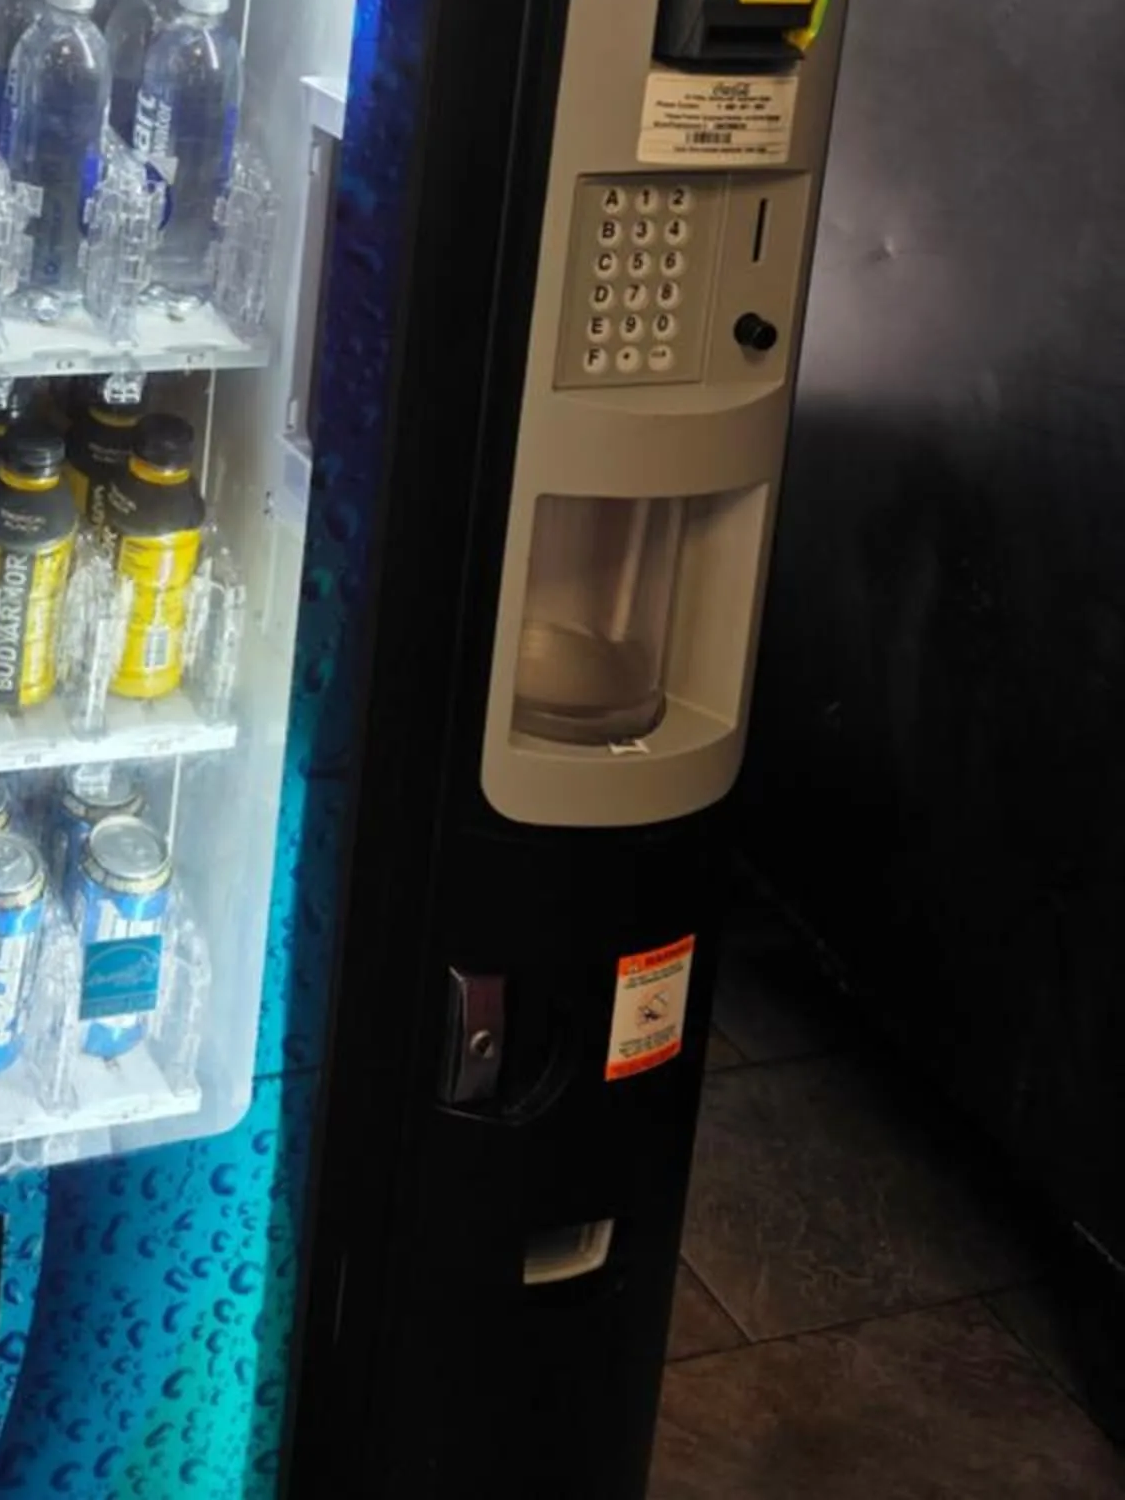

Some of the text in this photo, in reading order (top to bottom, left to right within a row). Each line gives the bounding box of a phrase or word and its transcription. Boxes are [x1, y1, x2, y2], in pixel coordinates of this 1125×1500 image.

[605, 188, 684, 205] A 1 2
[602, 221, 680, 238] B 3 4
[598, 253, 676, 270] C 5 6
[594, 284, 672, 302] D 7 8
[591, 315, 669, 334] E 9 0
[587, 349, 600, 366] F
